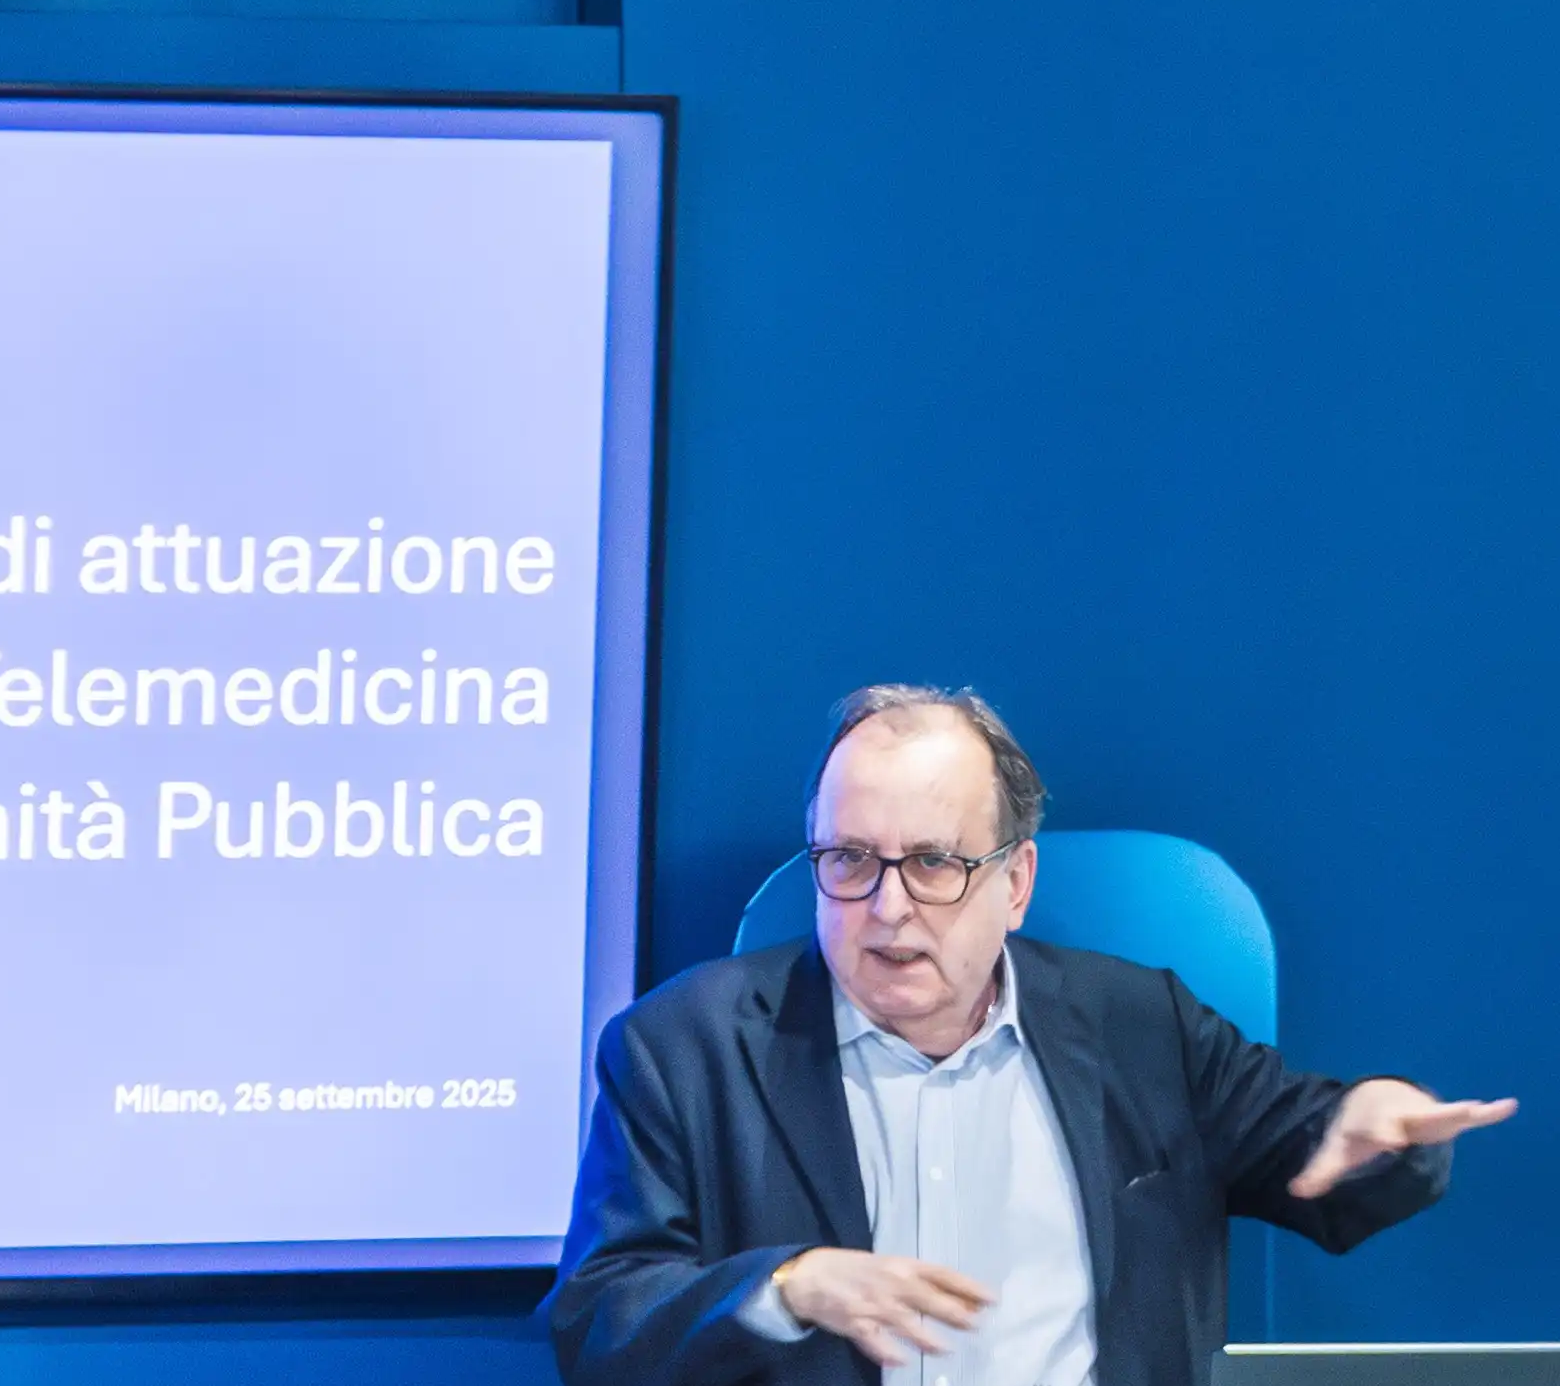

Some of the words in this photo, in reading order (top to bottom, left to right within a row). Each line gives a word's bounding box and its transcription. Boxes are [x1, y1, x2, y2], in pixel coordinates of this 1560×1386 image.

[79, 517, 554, 594] attuazione
[158, 780, 543, 859] Pubblica
[114, 1083, 227, 1116] Milano,
[232, 1082, 273, 1112] 25
[278, 1080, 434, 1111] settembre
[441, 1078, 517, 1108] 2025
